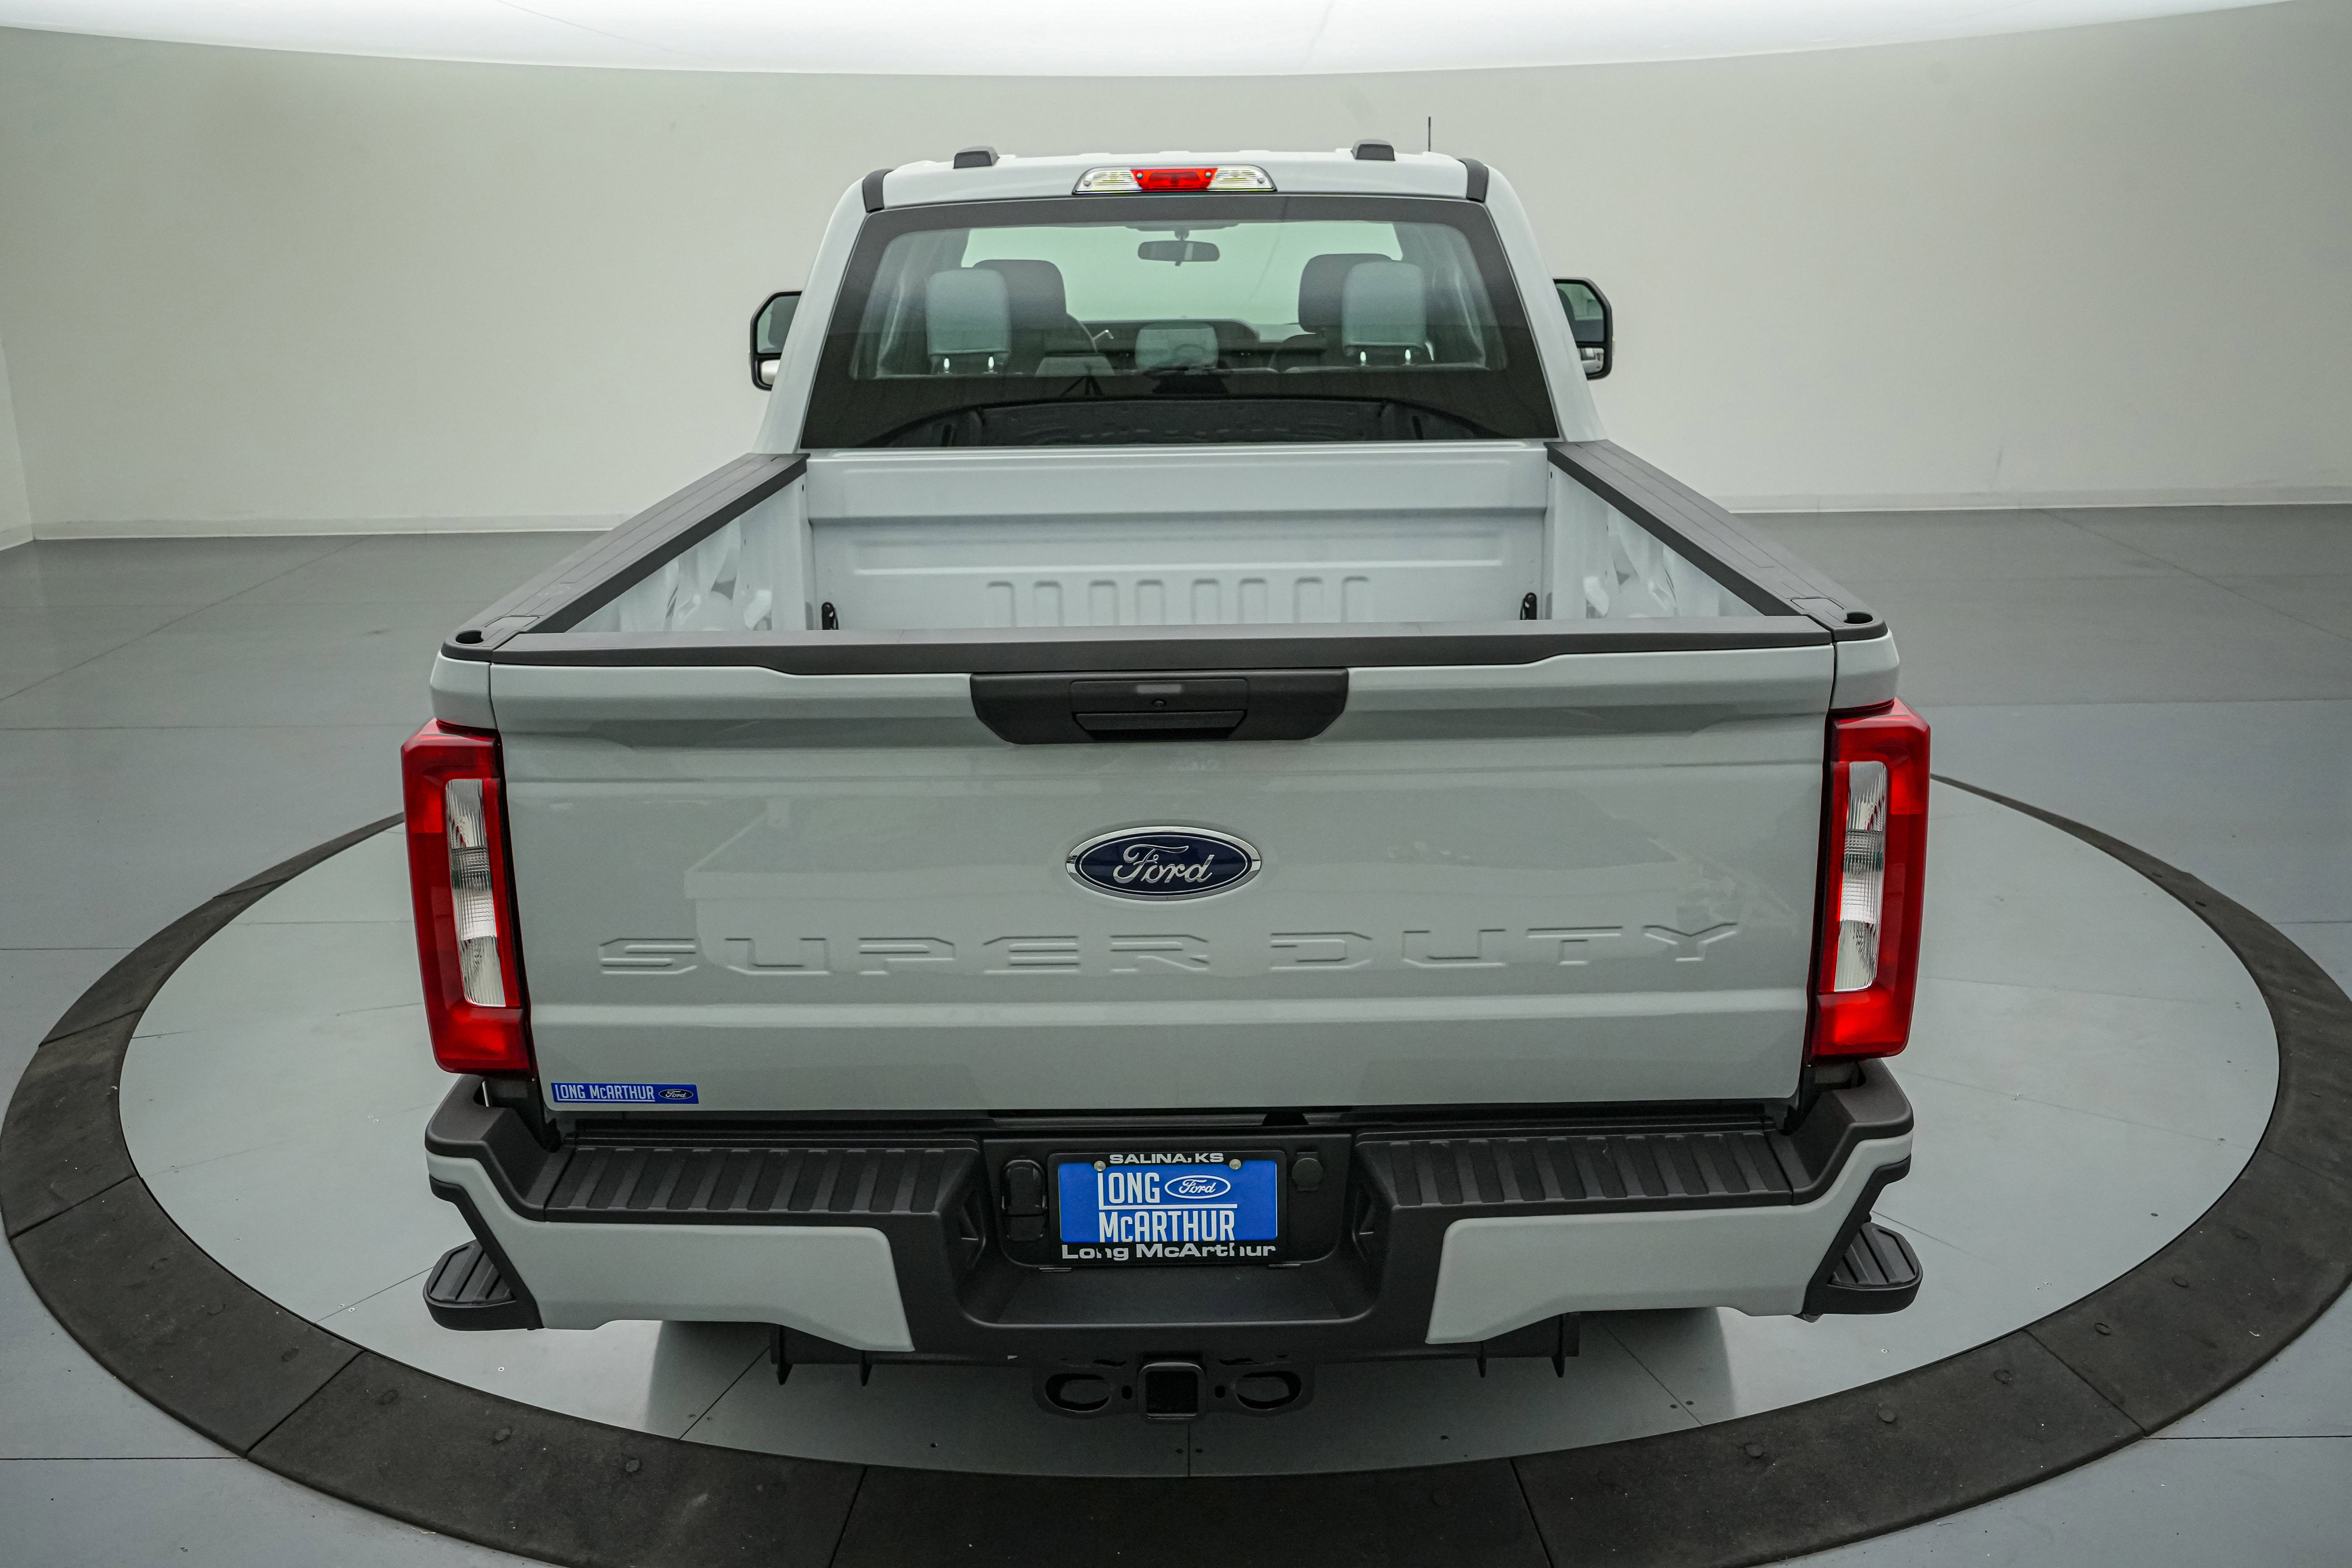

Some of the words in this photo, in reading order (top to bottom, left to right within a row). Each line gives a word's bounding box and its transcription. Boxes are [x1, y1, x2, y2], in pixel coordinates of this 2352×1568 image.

[1113, 844, 1214, 883] Ford
[599, 933, 1209, 976] SUPER
[1270, 922, 1738, 971] DUTY
[555, 1084, 586, 1101] LONG
[589, 1085, 655, 1100] McARTHUR
[665, 1090, 686, 1098] Ford
[1196, 1153, 1224, 1163] KS
[1098, 1172, 1160, 1209] LONG
[1178, 1179, 1216, 1195] Ford
[1099, 1211, 1235, 1243] McARTHUR
